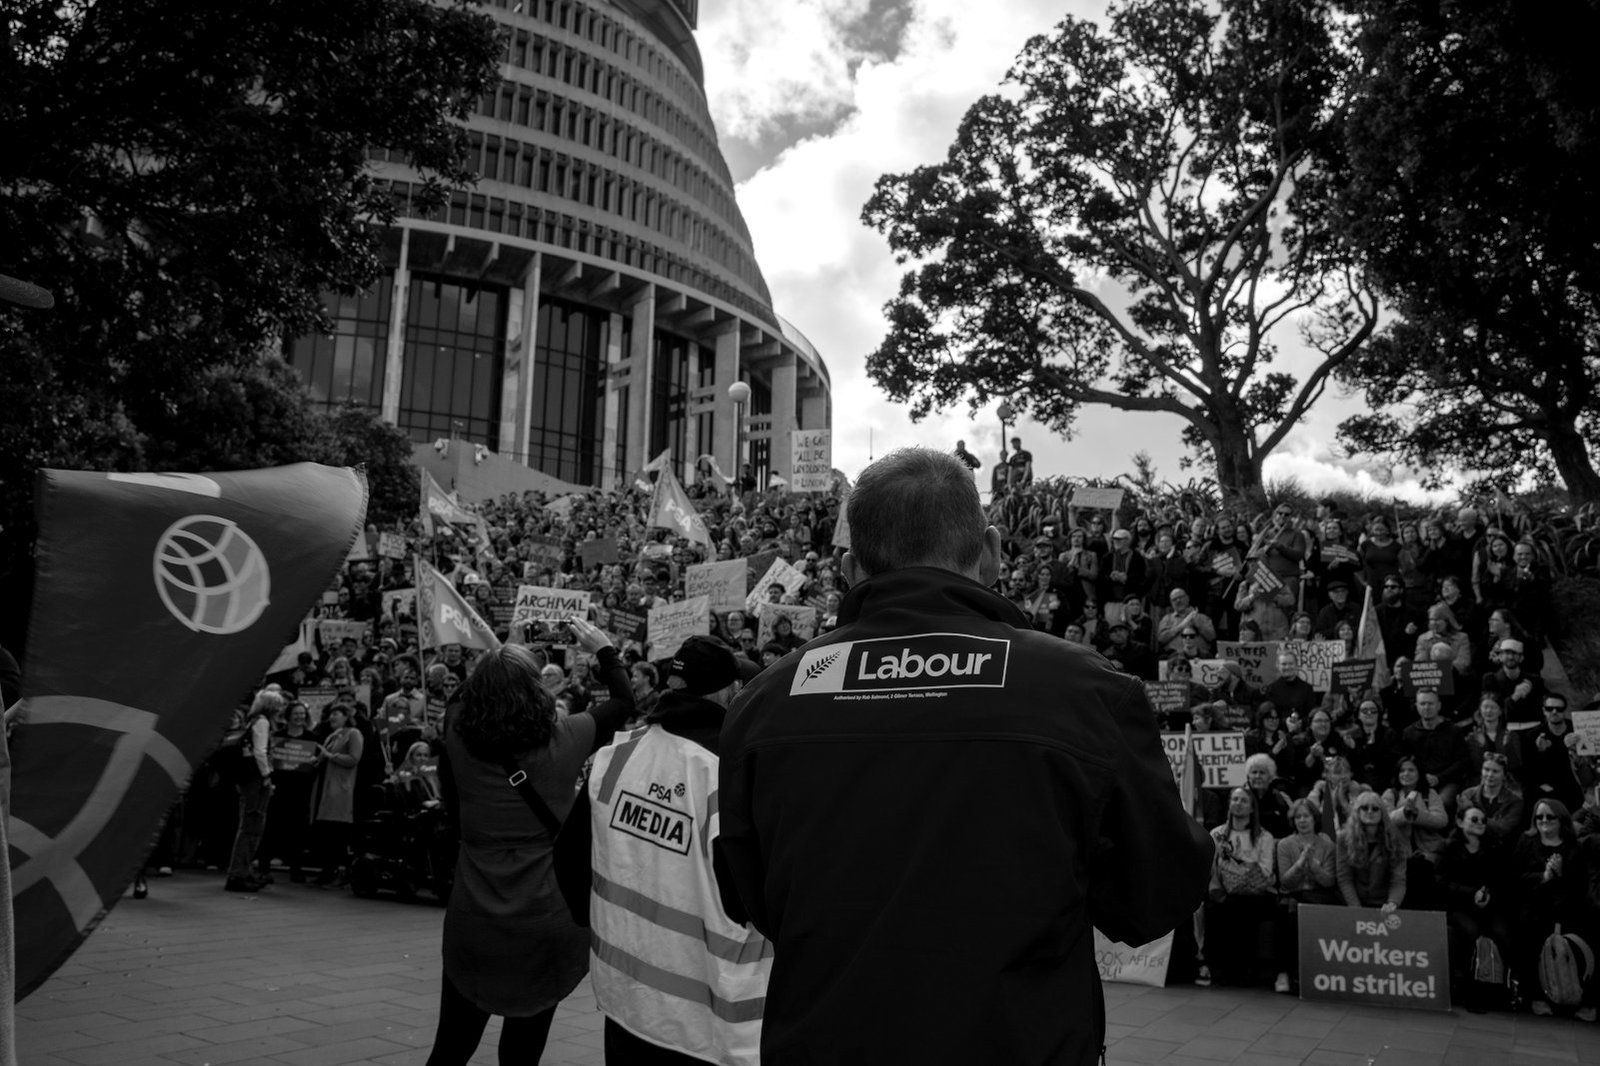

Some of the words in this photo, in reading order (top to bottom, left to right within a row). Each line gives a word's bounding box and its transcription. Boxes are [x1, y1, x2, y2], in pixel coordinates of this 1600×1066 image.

[428, 496, 453, 517] PSA
[665, 498, 691, 531] PSA
[689, 568, 713, 580] NOT
[519, 595, 586, 612] ARCHIVAL
[441, 603, 472, 640] PSA
[1225, 646, 1268, 658] BETTER
[858, 648, 992, 680] Labour
[1238, 657, 1261, 669] PAY
[1412, 662, 1438, 670] PUBLIC
[1409, 670, 1443, 678] SERVICES
[1412, 678, 1441, 686] MATTER
[1210, 736, 1243, 751] LET
[648, 783, 671, 803] PSA
[619, 801, 684, 845] MEDIA
[1356, 920, 1388, 936] PSA
[1095, 950, 1124, 966] OOK
[1128, 954, 1165, 968] AFTER
[1318, 938, 1429, 968] Workers
[1314, 973, 1347, 992] on
[1352, 972, 1436, 998] strike!
